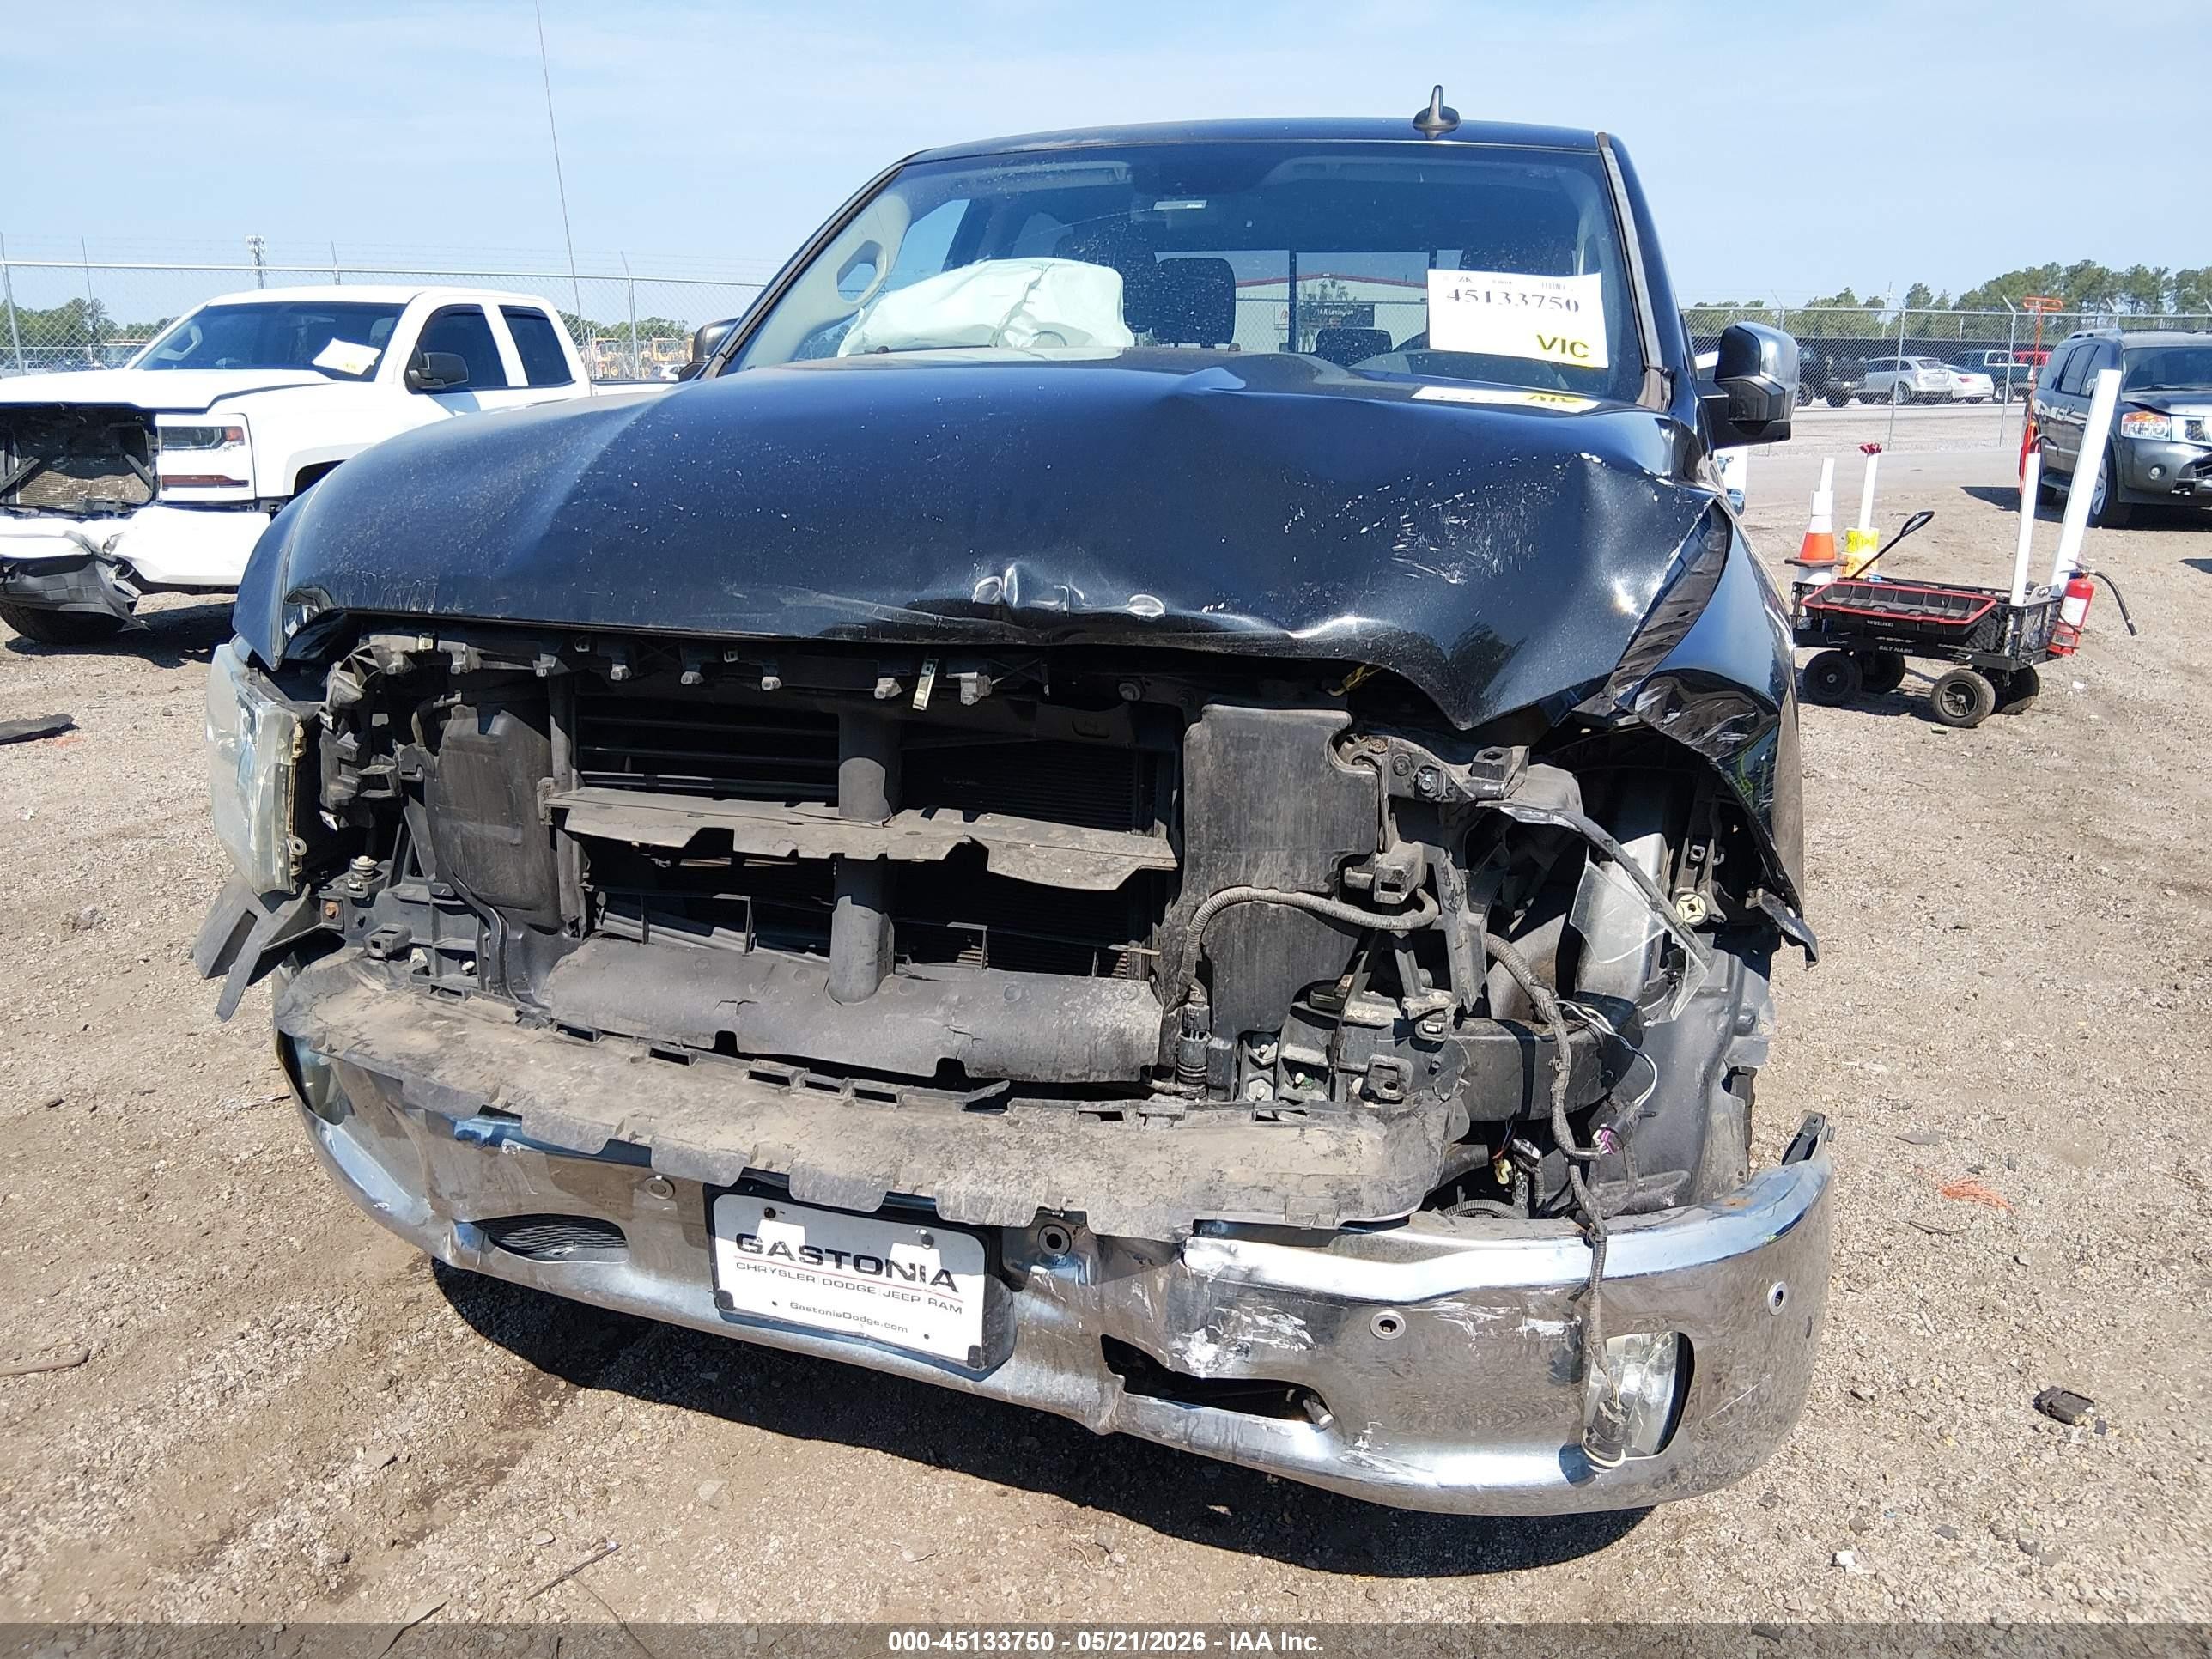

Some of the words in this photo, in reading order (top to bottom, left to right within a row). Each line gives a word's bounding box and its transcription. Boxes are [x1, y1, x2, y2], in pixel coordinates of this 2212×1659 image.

[1448, 289, 1579, 313] 45133750
[1536, 335, 1589, 358] VIC
[736, 1233, 959, 1293] GASTONIA
[736, 1261, 816, 1284] CHRYSLER
[822, 1278, 877, 1295] DODGE
[882, 1289, 921, 1304] JEEP
[928, 1297, 963, 1315] RAM
[789, 1301, 908, 1334] GastoniaDodge.com
